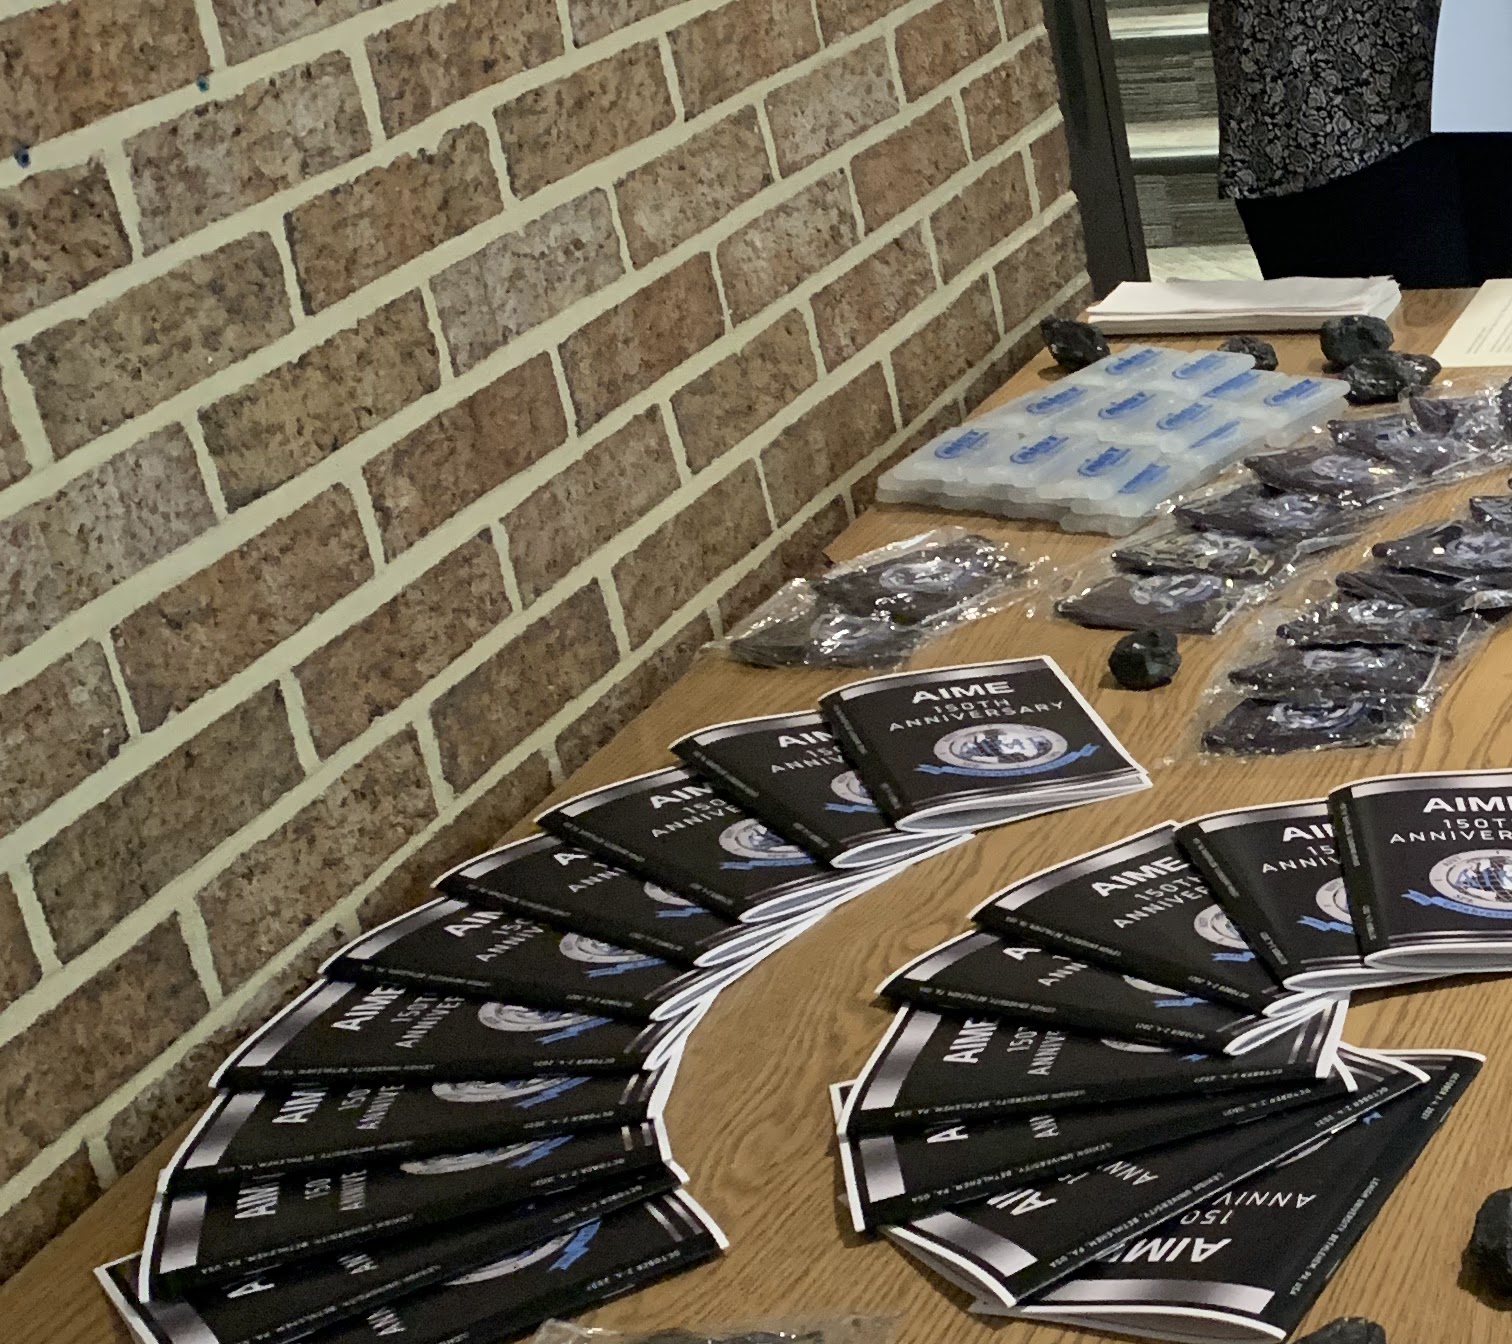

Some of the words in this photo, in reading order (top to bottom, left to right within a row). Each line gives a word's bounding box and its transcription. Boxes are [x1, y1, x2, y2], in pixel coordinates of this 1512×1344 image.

[912, 681, 1015, 704] AIME
[889, 700, 1063, 732] ANNIVERSARY
[934, 699, 1010, 714] 150TH
[1091, 855, 1190, 897] AIME
[1351, 1084, 1389, 1109] OCTOBER
[1312, 1111, 1335, 1127] 2021
[1190, 1170, 1225, 1193] LEHIGH
[1181, 1209, 1234, 1225] 150
[1047, 1252, 1070, 1269] USA
[1101, 1237, 1232, 1263] AIM
